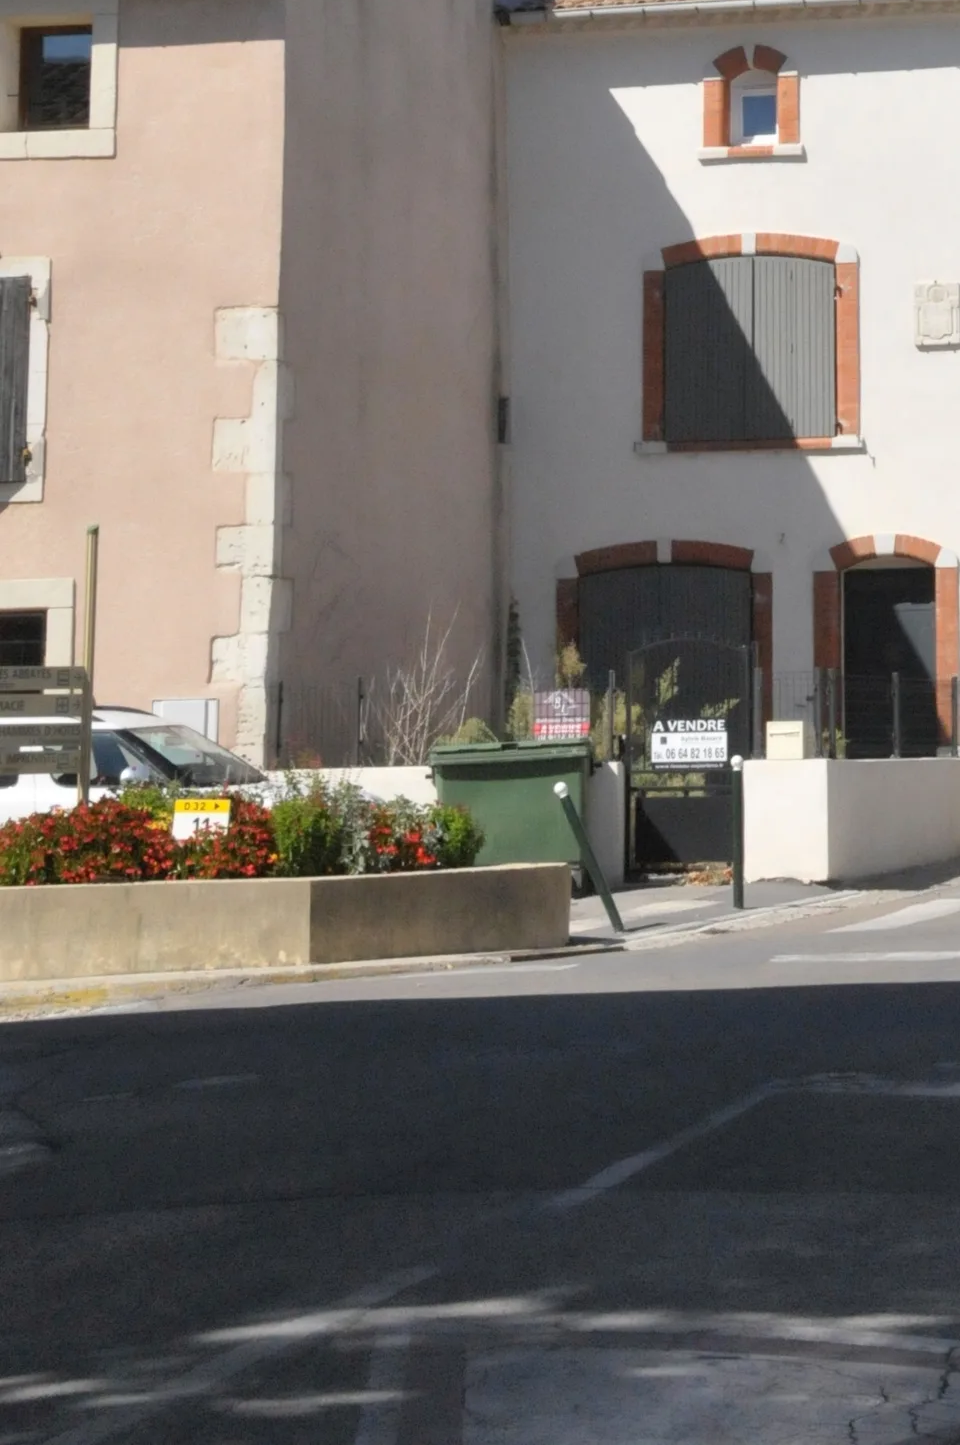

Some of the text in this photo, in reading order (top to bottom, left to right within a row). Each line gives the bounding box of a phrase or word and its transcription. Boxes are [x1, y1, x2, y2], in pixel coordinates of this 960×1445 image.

[653, 719, 726, 732] A VENDRE
[665, 748, 676, 759] 06
[678, 748, 688, 759] 64
[690, 748, 701, 759] 82
[703, 747, 713, 758] 18
[714, 747, 725, 758] 65
